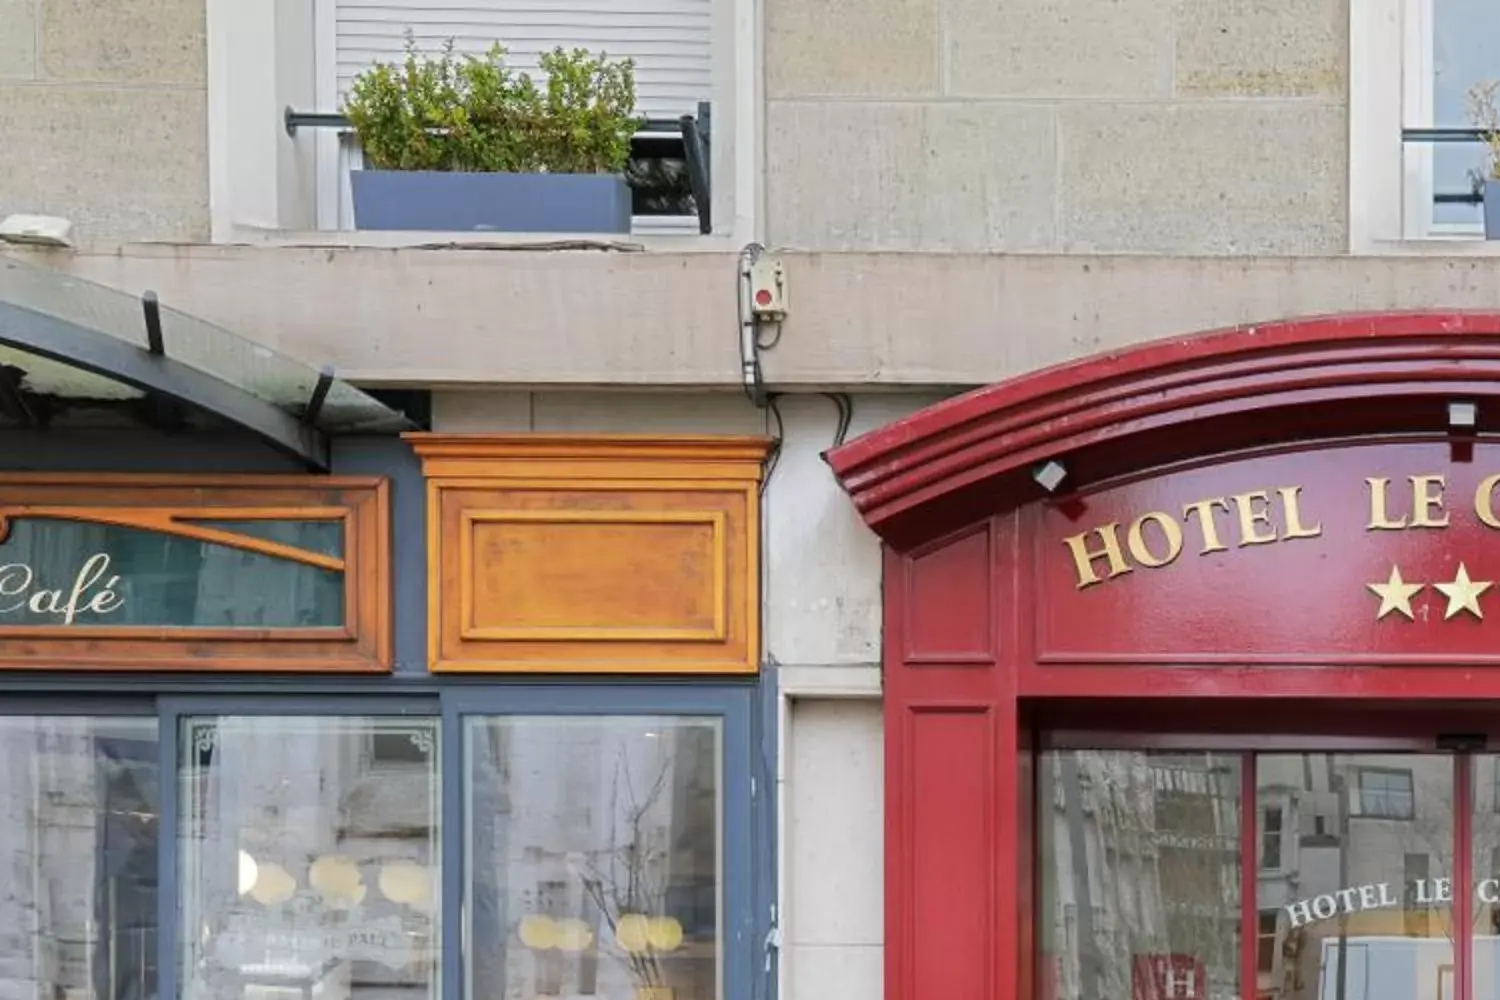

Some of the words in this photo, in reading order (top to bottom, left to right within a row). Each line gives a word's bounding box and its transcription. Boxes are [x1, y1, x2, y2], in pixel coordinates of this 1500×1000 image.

[1063, 483, 1323, 590] HOTEL
[1364, 473, 1450, 532] LE
[0, 553, 125, 625] Café
[1285, 882, 1397, 928] HOTEL
[1416, 878, 1452, 904] LE
[1166, 968, 1194, 998] H
